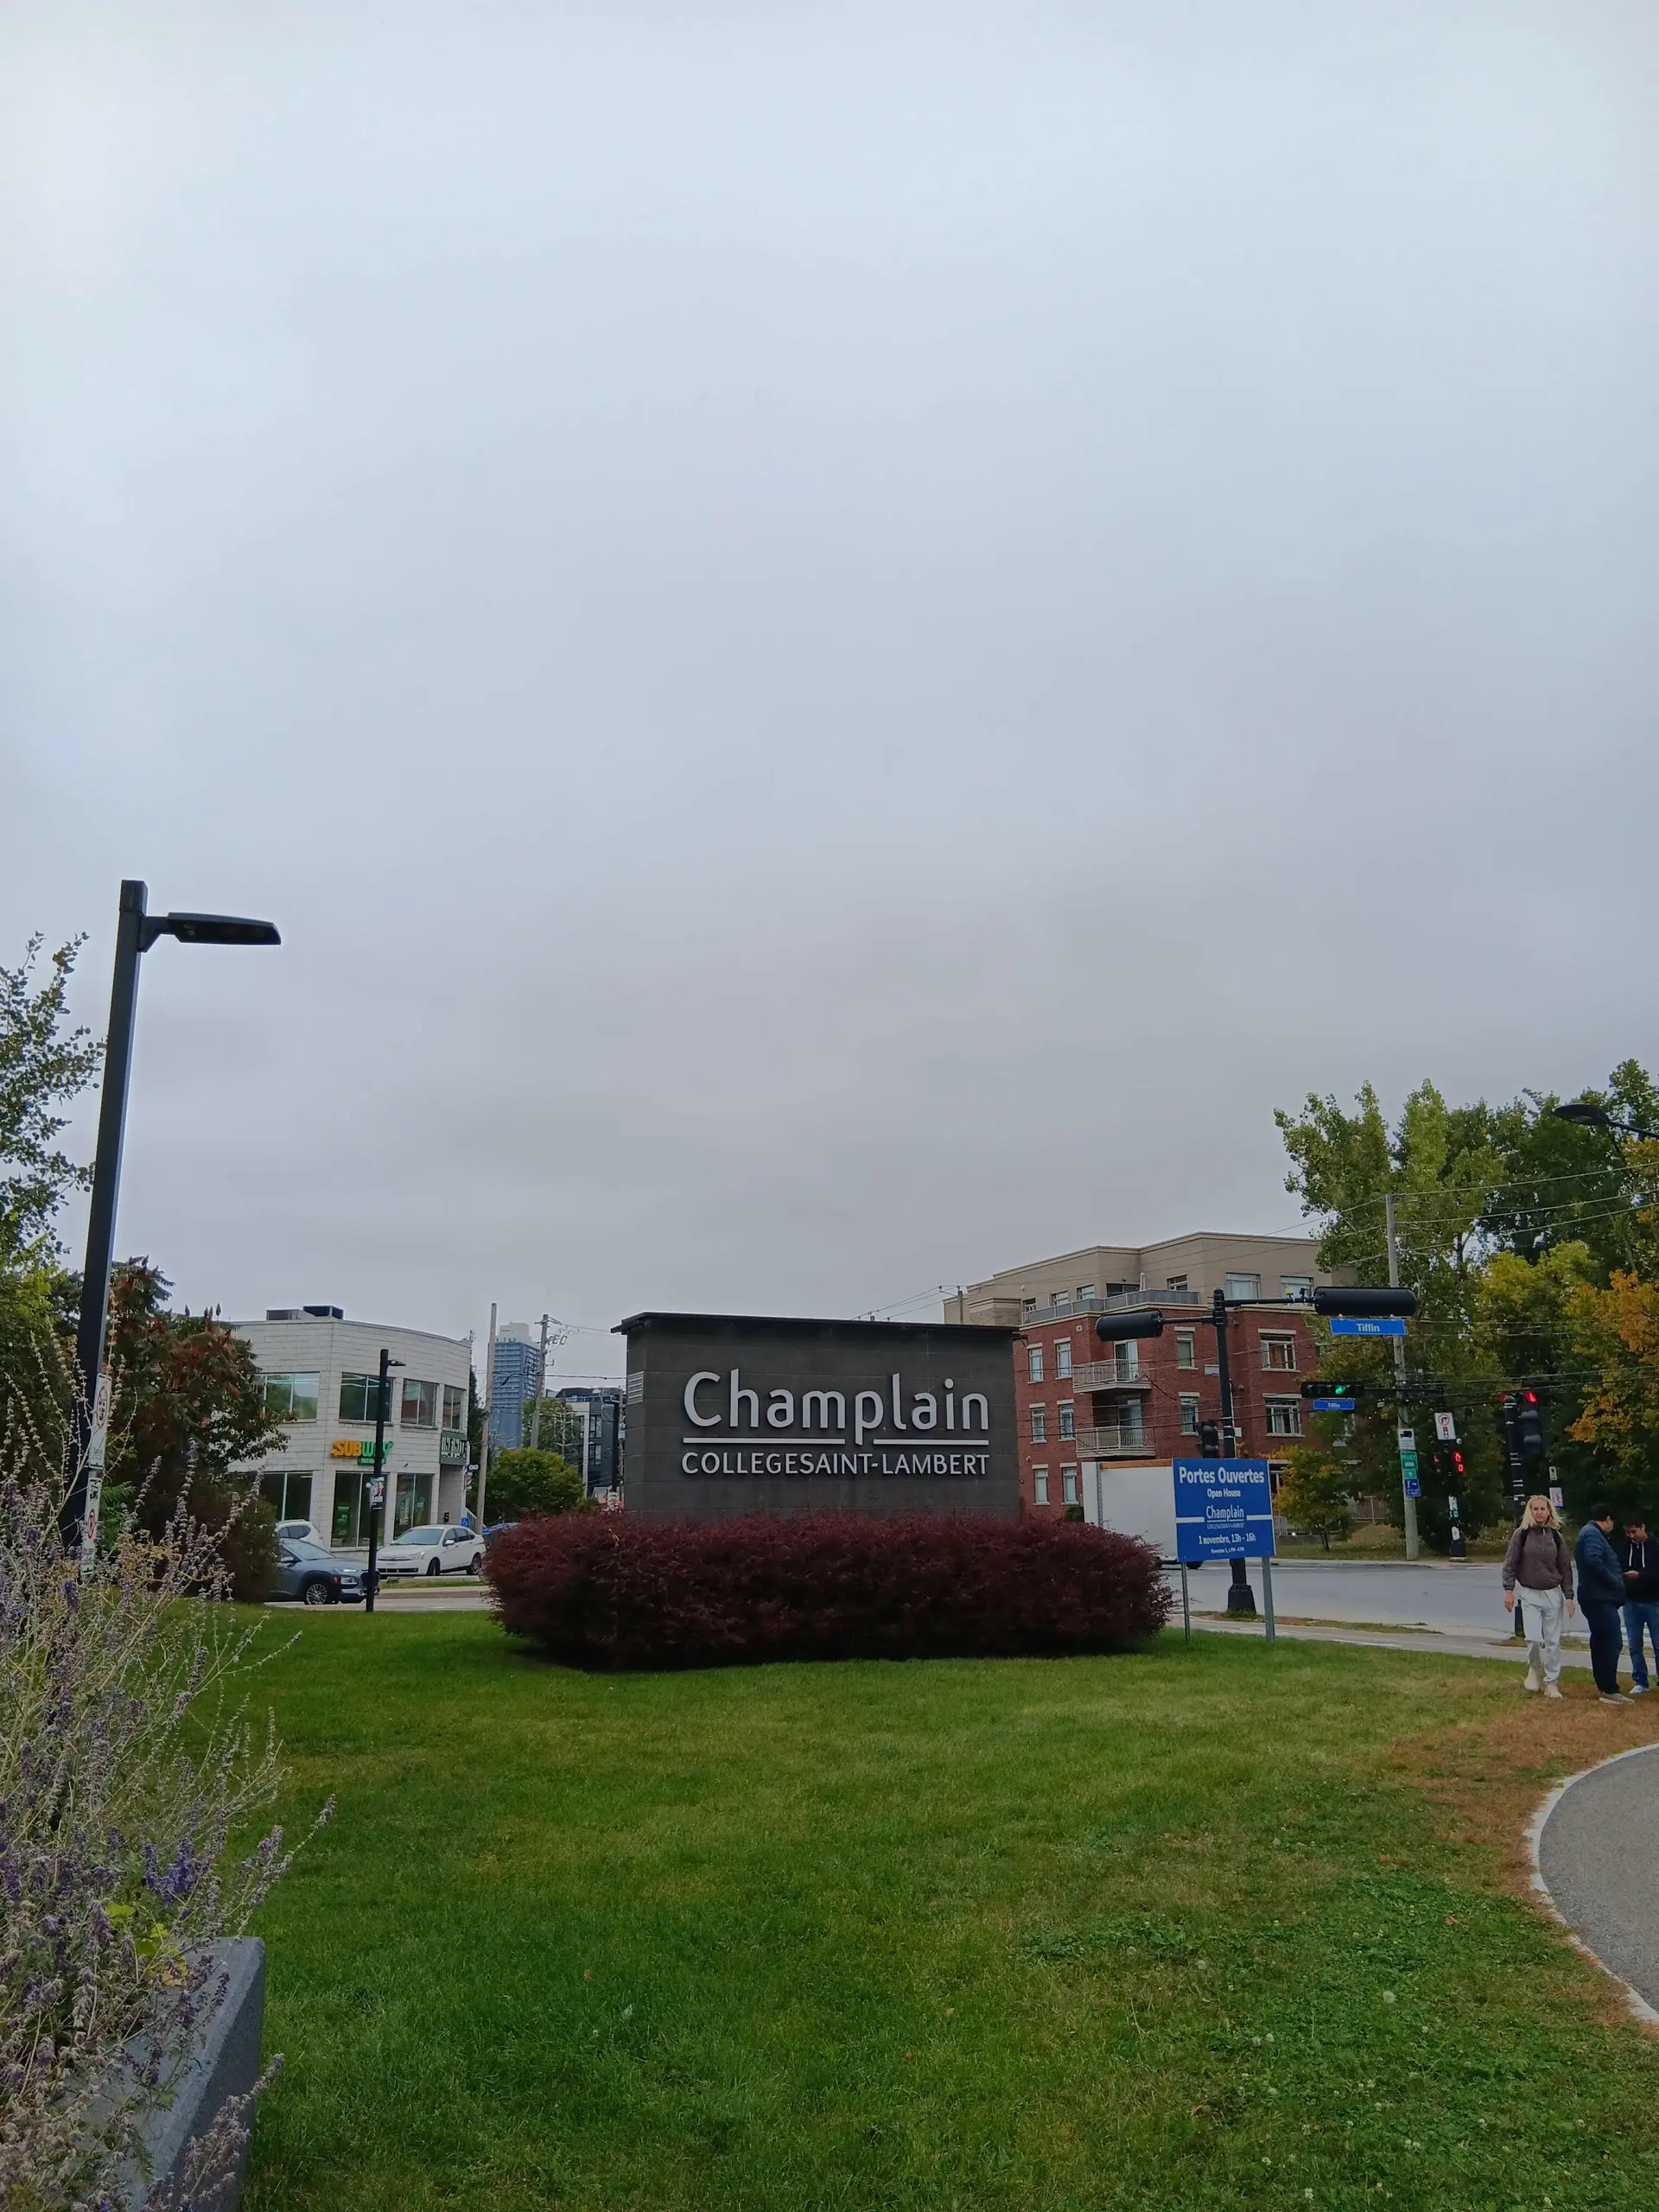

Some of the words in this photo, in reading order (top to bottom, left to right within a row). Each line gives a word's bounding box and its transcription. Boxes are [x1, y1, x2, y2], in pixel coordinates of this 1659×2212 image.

[1356, 1323, 1380, 1332] Tiffin
[683, 1368, 989, 1446] Champlain
[331, 1440, 394, 1459] SUBWY
[1179, 1466, 1216, 1484] Portes
[1217, 1466, 1265, 1484] Ouvertes
[1207, 1488, 1223, 1499] Open
[1224, 1488, 1242, 1497] House
[1205, 1504, 1244, 1522] Champlain
[1198, 1535, 1203, 1544] 1
[1203, 1535, 1230, 1544] novembre,
[1231, 1533, 1242, 1543] 13h
[1245, 1532, 1256, 1542] 16h
